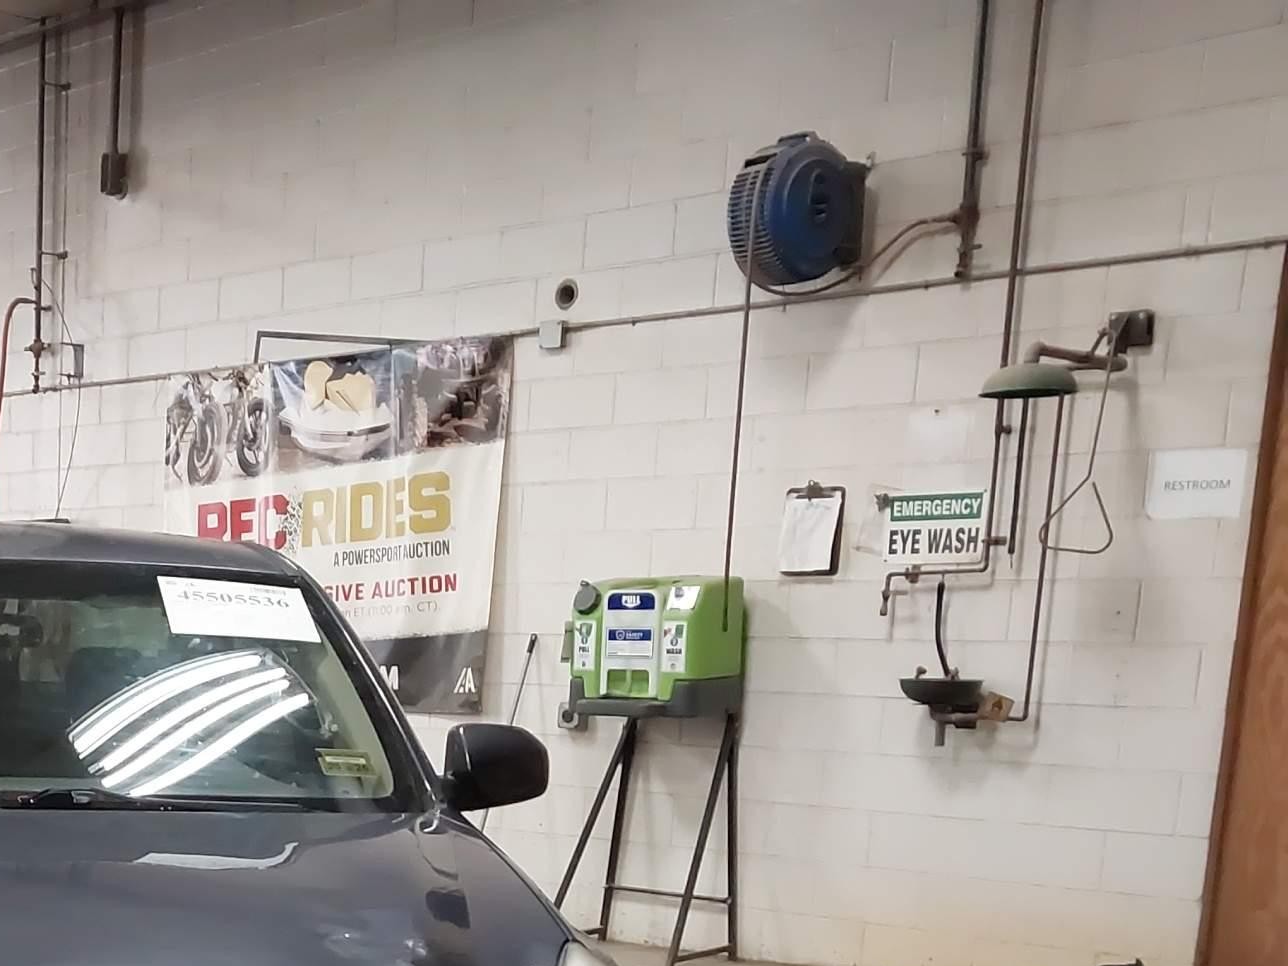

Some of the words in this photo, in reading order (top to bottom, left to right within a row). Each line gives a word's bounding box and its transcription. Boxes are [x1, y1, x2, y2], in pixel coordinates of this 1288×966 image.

[1163, 479, 1231, 491] RESTROOM
[198, 494, 289, 550] REC
[301, 471, 451, 547] RIDES
[893, 498, 981, 517] EMERGENCY
[888, 529, 922, 555] EYE
[927, 527, 980, 554] WASH
[333, 551, 340, 567] A
[371, 573, 457, 599] AUCTION
[177, 590, 290, 609] 45505536
